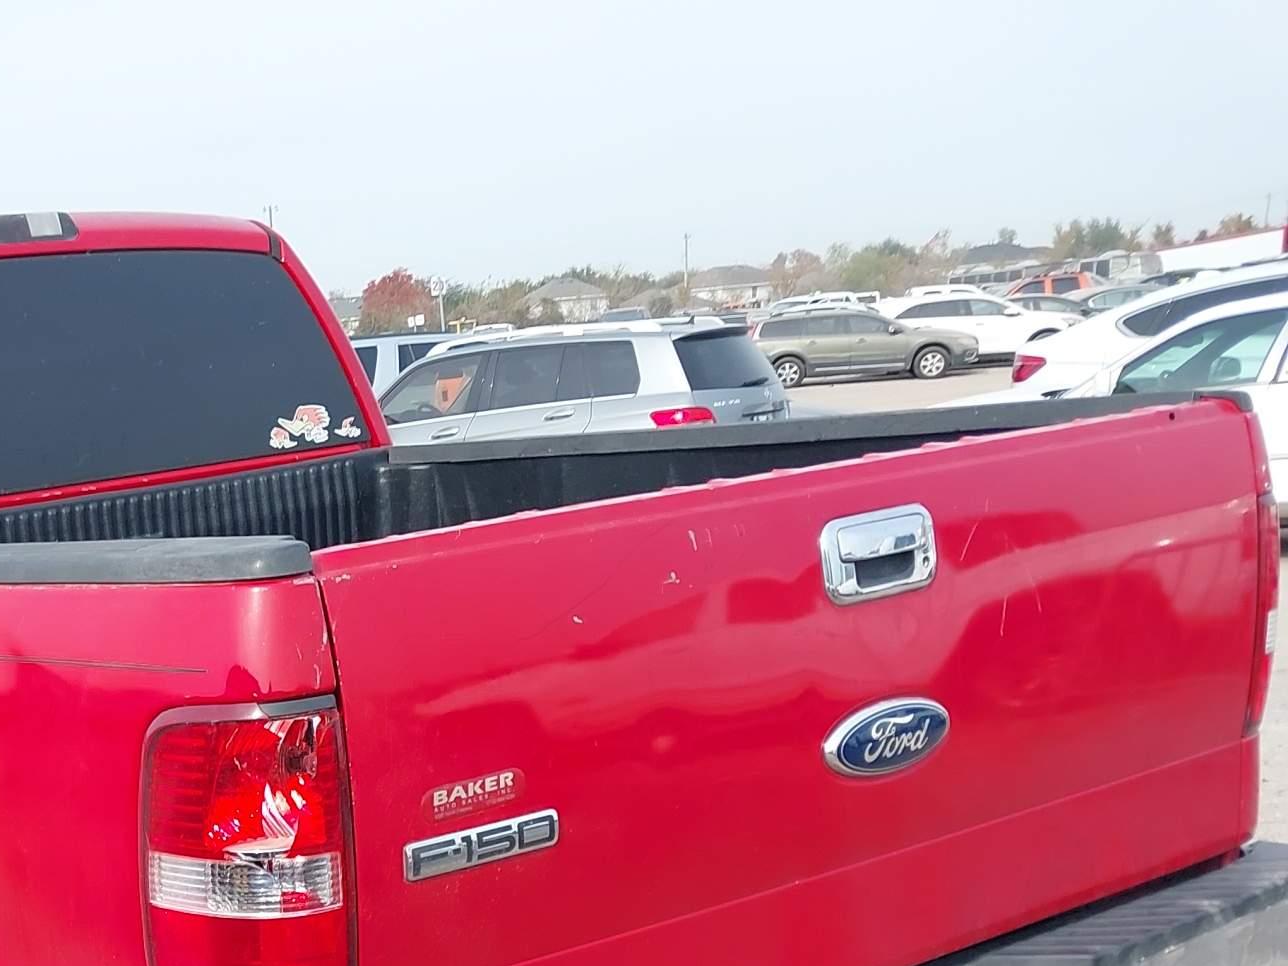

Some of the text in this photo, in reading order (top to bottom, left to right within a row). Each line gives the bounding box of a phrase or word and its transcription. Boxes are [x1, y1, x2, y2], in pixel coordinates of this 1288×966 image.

[864, 713, 930, 763] Ford
[433, 771, 514, 807] BAKER
[434, 803, 457, 813] AUTO
